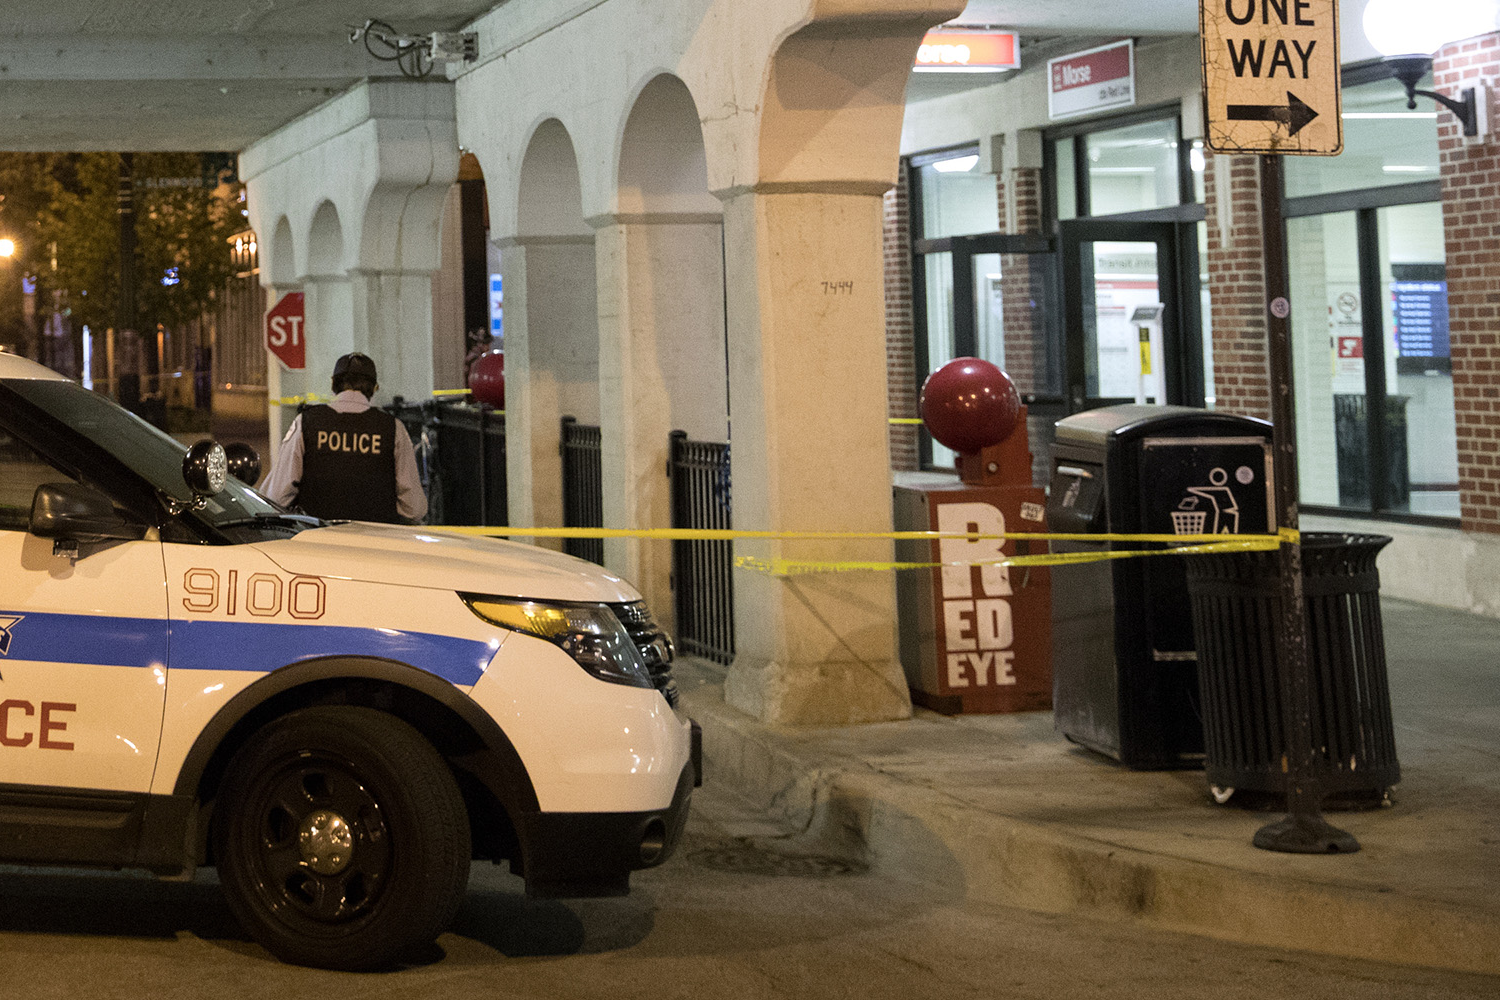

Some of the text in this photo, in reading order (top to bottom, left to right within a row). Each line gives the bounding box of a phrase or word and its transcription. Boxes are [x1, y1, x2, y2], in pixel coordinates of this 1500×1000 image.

[916, 44, 971, 65] orse
[1226, 38, 1318, 81] WAY
[1062, 64, 1092, 85] Morse
[820, 280, 854, 295] 7444
[270, 315, 303, 347] ST
[317, 430, 382, 455] POLICE
[182, 567, 327, 620] 9100
[946, 651, 1017, 688] EYE
